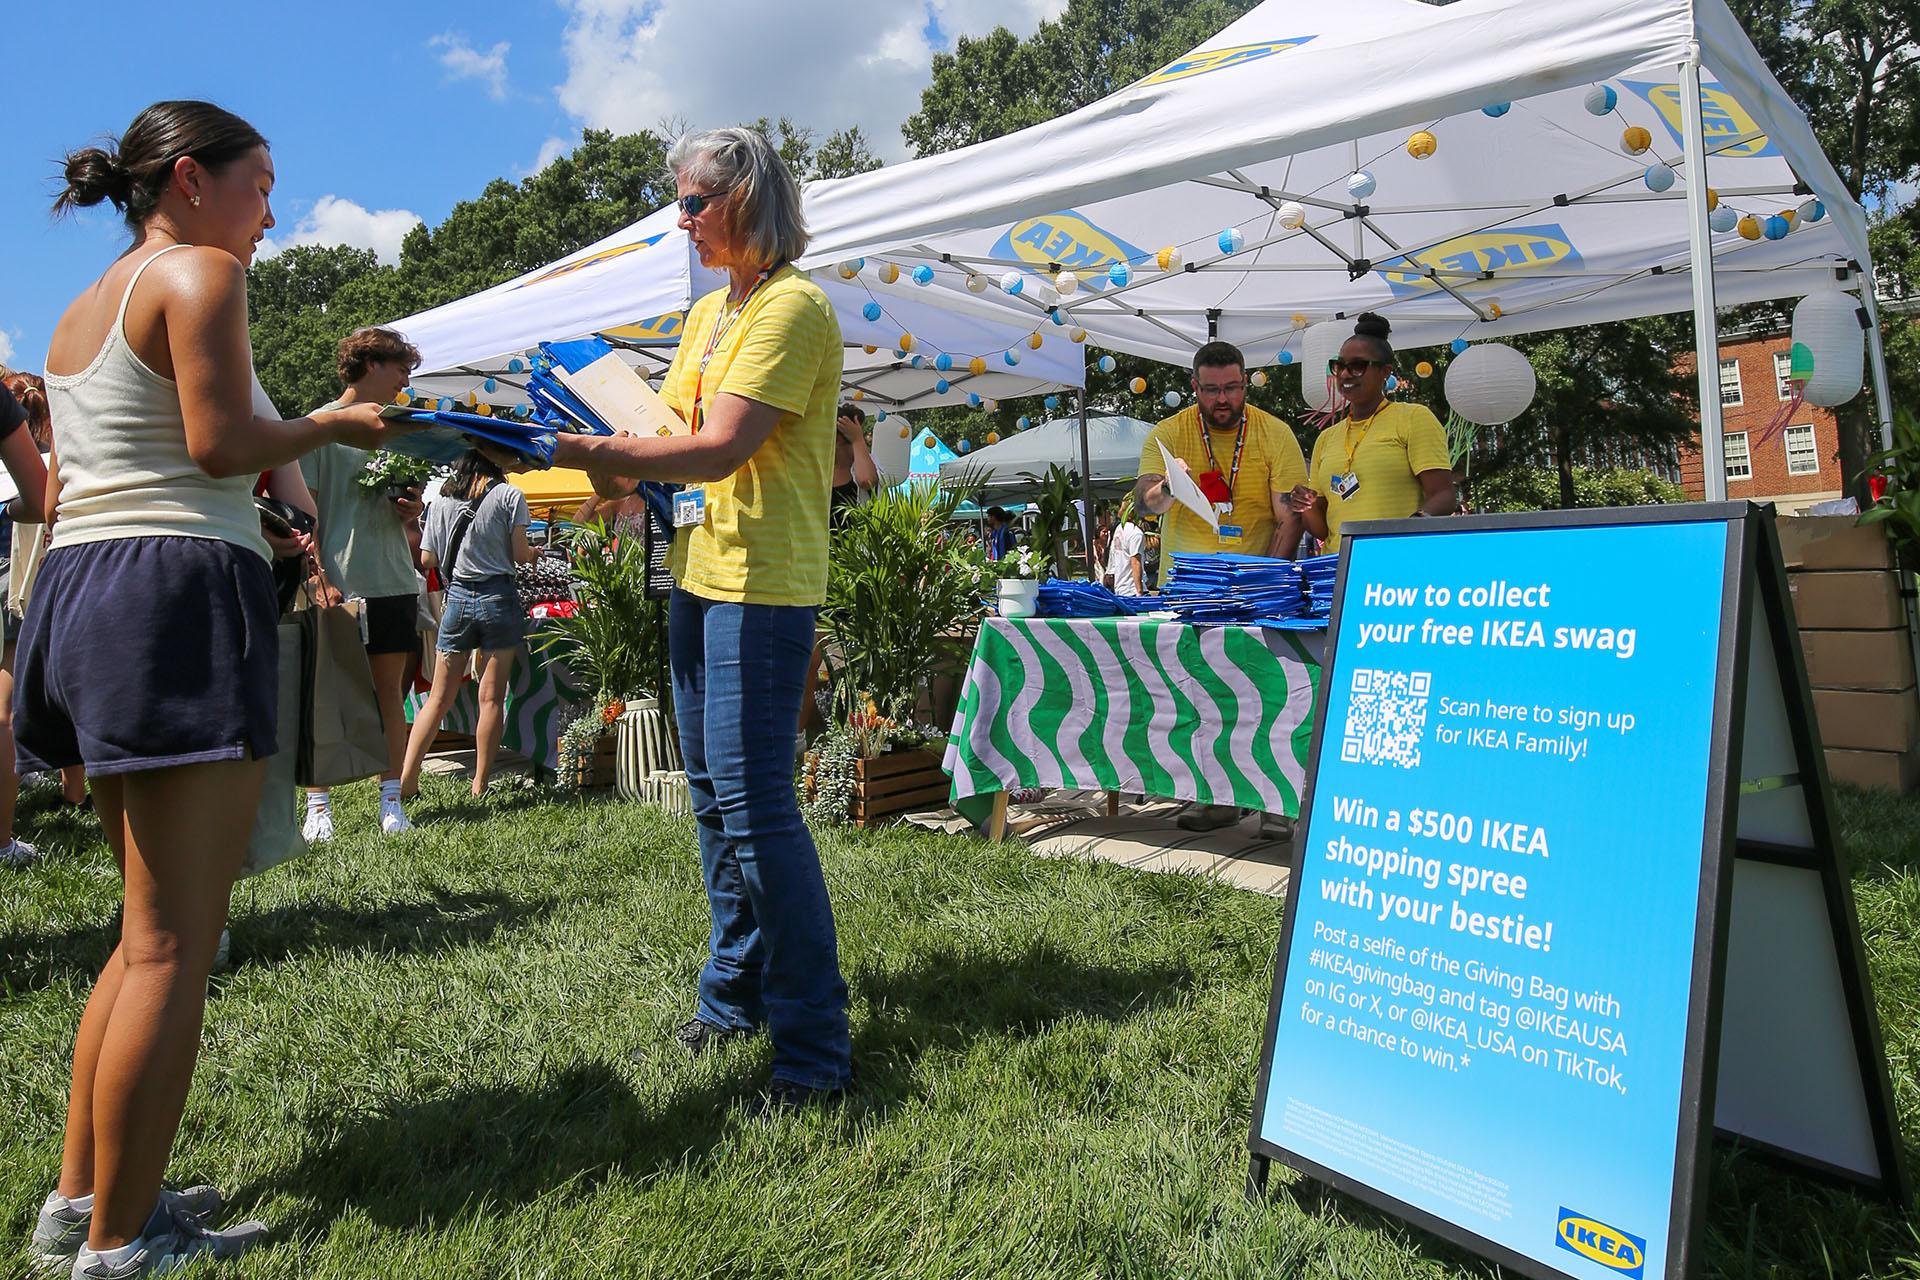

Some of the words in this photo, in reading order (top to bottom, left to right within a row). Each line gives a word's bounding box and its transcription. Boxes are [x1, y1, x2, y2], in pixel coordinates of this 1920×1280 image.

[1364, 583, 1419, 606] How
[1424, 584, 1451, 607] to
[1458, 580, 1551, 607] collect
[1357, 623, 1415, 649] your
[1421, 618, 1474, 645] free
[1482, 621, 1545, 647] IKEA
[1553, 627, 1636, 659] swag
[1436, 724, 1462, 744] for
[1467, 728, 1509, 749] IKEA
[1515, 732, 1588, 762] Family!
[1439, 696, 1480, 716] Scan
[1485, 699, 1528, 721] here
[1533, 705, 1553, 723] to
[1558, 706, 1600, 731] sign
[1607, 712, 1635, 735] up
[1334, 796, 1378, 828] Win
[1385, 810, 1400, 831] a
[1408, 808, 1473, 843] $500
[1482, 819, 1549, 858] IKEA
[1326, 835, 1441, 889] shopping
[1448, 864, 1527, 899] spree
[1322, 877, 1373, 910] with
[1378, 892, 1443, 925] your
[1450, 900, 1552, 952] bestie!
[1314, 921, 1347, 945] Post
[1349, 934, 1359, 948] a
[1363, 937, 1405, 961] selfie
[1410, 947, 1429, 966] of
[1431, 951, 1460, 975] the
[1465, 960, 1524, 998] Giving
[1530, 976, 1568, 1010] Bag
[1575, 991, 1620, 1019] with
[1302, 1002, 1323, 1024] for
[1326, 1016, 1335, 1030] a
[1339, 1017, 1396, 1050] chance
[1401, 1037, 1418, 1057] to
[1309, 949, 1435, 1005] #IKEAgivingbag
[1440, 989, 1475, 1011] and
[1480, 997, 1510, 1027] tag
[1516, 1007, 1627, 1056] @IKEAUSA
[1306, 980, 1324, 997] on
[1329, 983, 1345, 1003] IG
[1349, 993, 1367, 1008] or
[1369, 994, 1382, 1018] X,
[1389, 1005, 1407, 1021] or
[1411, 1009, 1516, 1057] @IKEA_USA
[1522, 1046, 1548, 1067] on
[1554, 1049, 1626, 1094] TikTok,
[1565, 1221, 1637, 1266] IKEA
